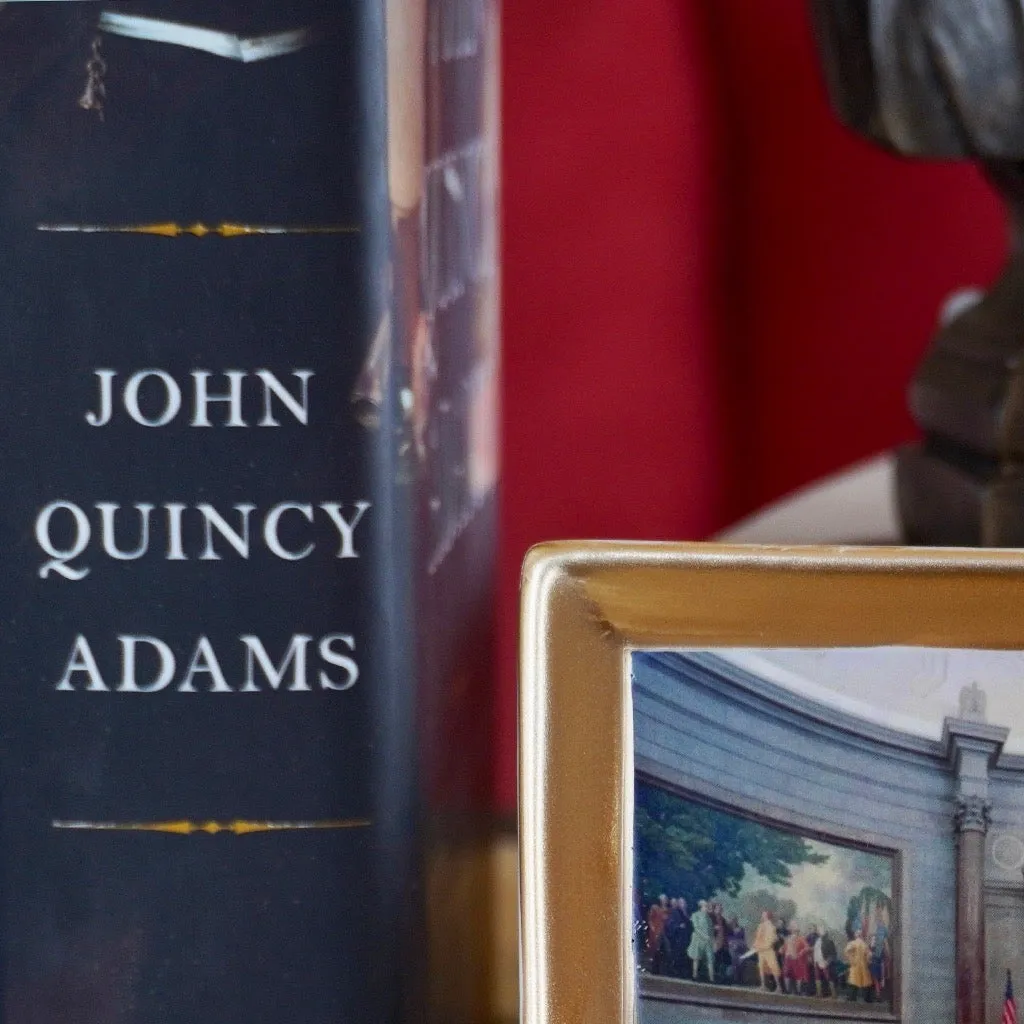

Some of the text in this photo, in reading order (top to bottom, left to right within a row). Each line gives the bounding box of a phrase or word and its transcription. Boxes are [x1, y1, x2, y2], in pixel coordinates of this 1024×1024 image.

[85, 368, 315, 428] JOHN
[35, 500, 372, 581] QUINCY
[55, 633, 360, 693] ADAMS
